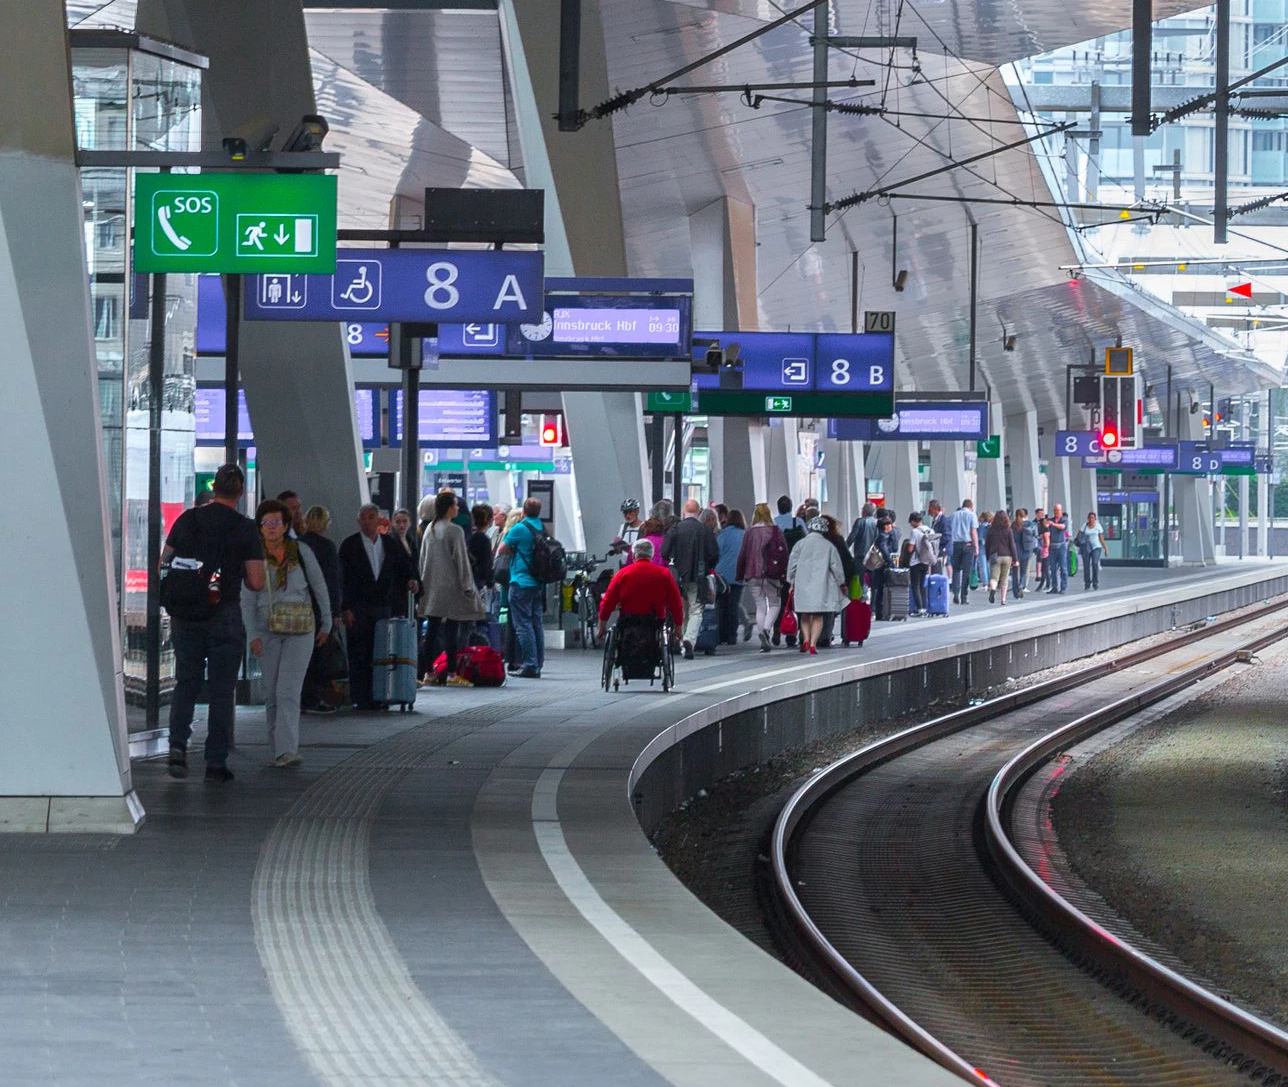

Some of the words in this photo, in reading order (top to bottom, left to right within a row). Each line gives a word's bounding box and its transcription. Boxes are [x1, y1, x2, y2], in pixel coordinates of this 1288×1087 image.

[174, 196, 212, 214] SOS
[424, 261, 459, 310] 8
[492, 274, 527, 310] A
[554, 320, 612, 331] Innsbruck
[616, 320, 637, 331] Hbf
[870, 313, 890, 330] 70
[347, 323, 363, 345] 8
[831, 359, 850, 385] 8
[869, 366, 884, 385] B
[1064, 435, 1077, 453] 8
[1088, 439, 1099, 453] C
[1192, 456, 1202, 470] 8
[1210, 459, 1219, 470] D
